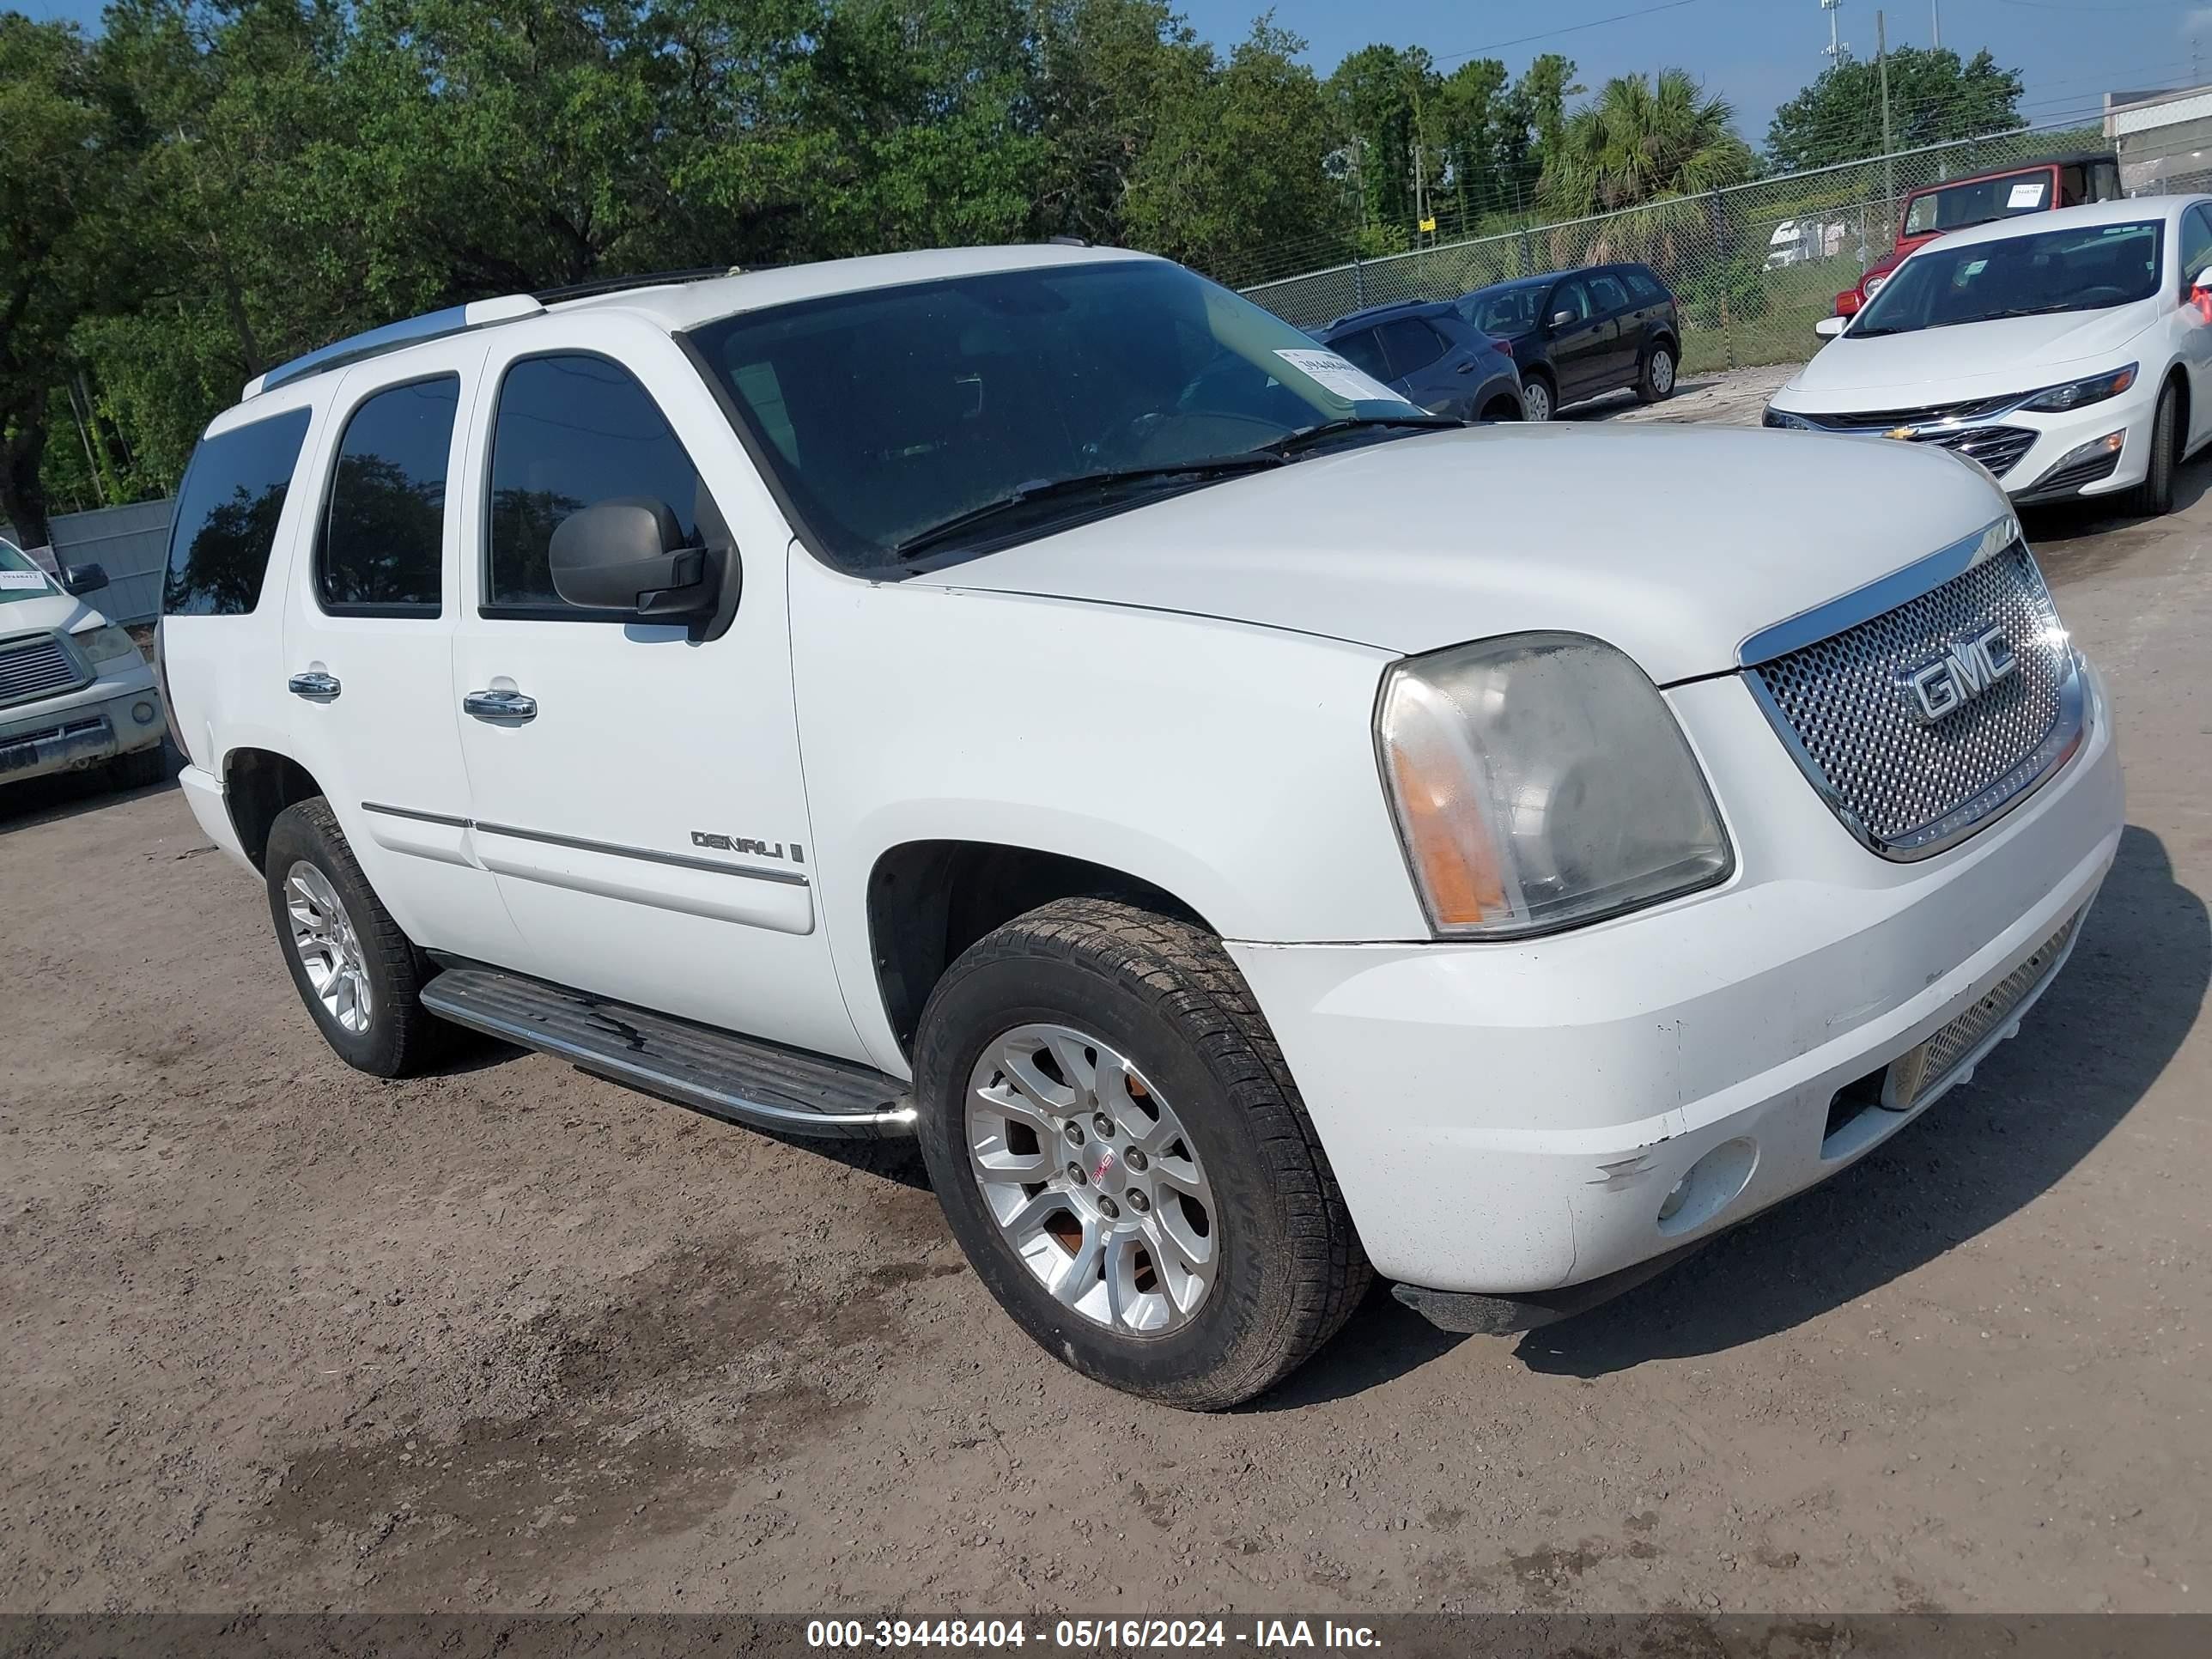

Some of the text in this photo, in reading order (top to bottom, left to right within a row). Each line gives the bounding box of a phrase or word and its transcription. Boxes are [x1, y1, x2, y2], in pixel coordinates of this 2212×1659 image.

[1912, 623, 2018, 721] GMC
[690, 830, 784, 860] DENALI
[1091, 1153, 1114, 1186] GMC
